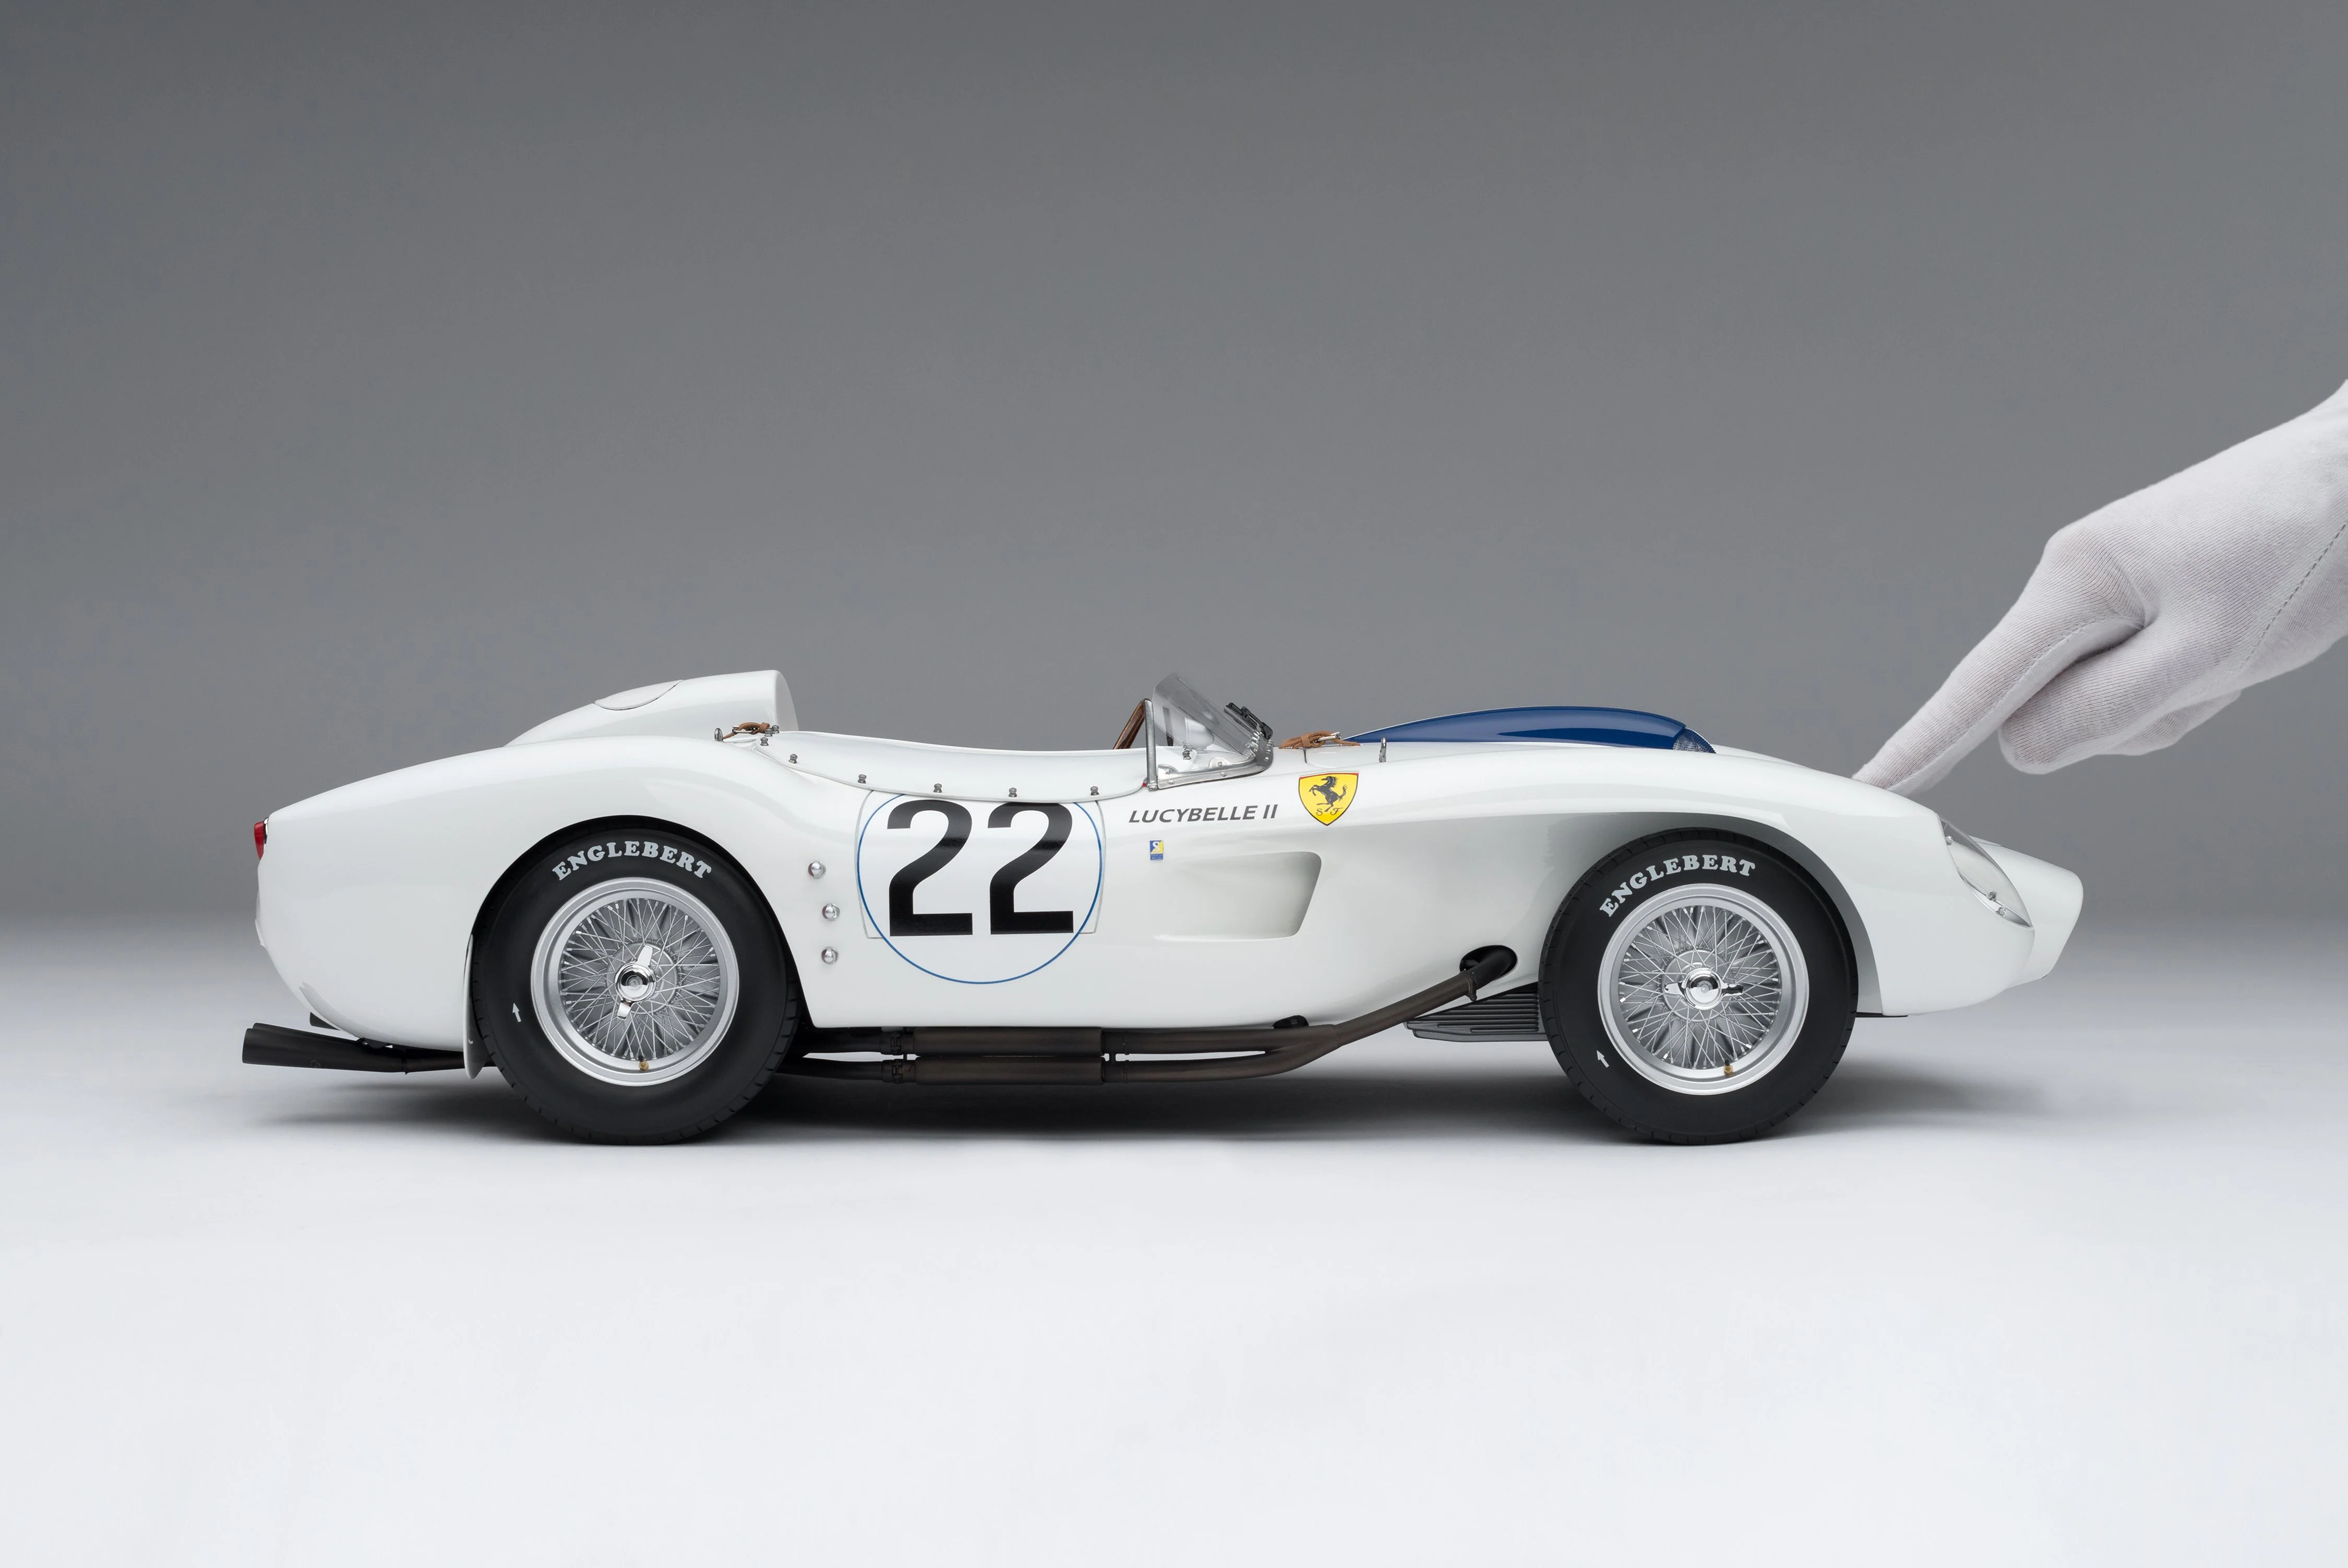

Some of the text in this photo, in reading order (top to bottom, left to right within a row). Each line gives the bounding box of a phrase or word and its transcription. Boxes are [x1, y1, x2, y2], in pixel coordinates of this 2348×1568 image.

[1129, 804, 1278, 823] LUCYBELLE II
[552, 841, 712, 881] ENGLEBERT
[887, 799, 1074, 937] 22
[1599, 854, 1756, 917] ENGLEBERT
